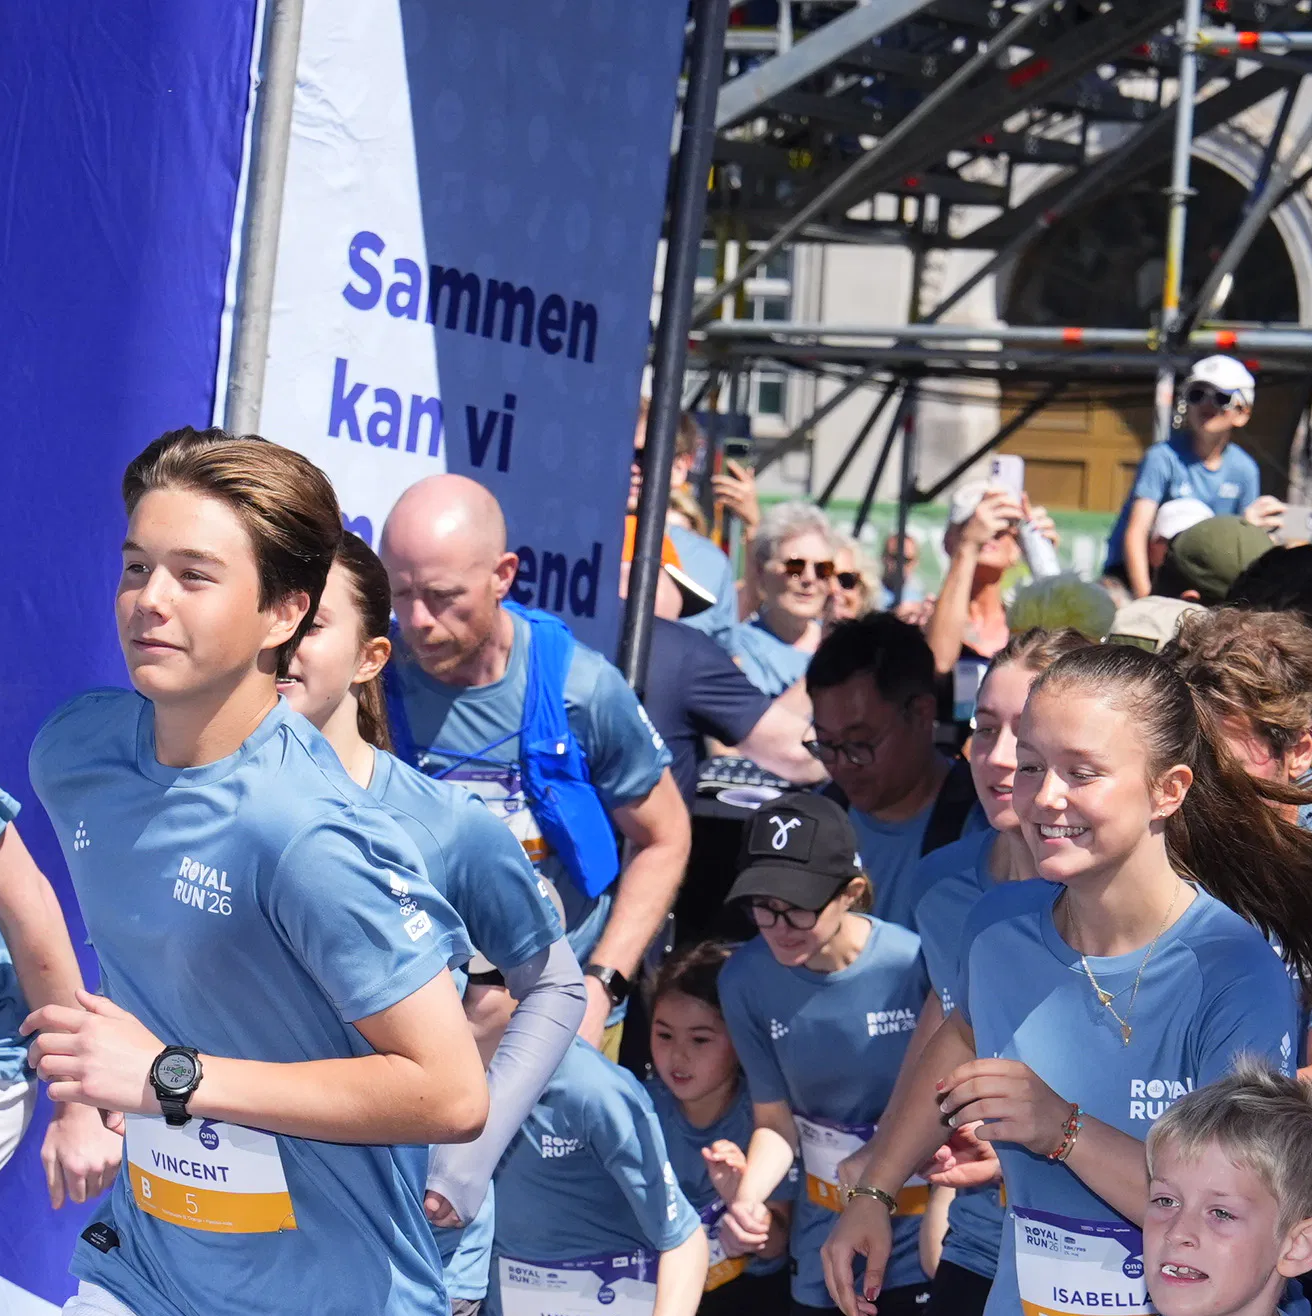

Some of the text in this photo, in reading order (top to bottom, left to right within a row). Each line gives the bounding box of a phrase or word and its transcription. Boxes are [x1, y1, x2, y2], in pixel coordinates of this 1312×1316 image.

[342, 230, 600, 364] Sammen
[327, 356, 518, 473] kan vi
[178, 856, 233, 893] ROYAL
[866, 1008, 916, 1025] ROYAL
[200, 1131, 217, 1140] one
[151, 1149, 229, 1182] VINCENT
[140, 1176, 199, 1214] B 5
[1024, 1225, 1059, 1242] ROYAL
[1052, 1286, 1154, 1308] ISABELLA
